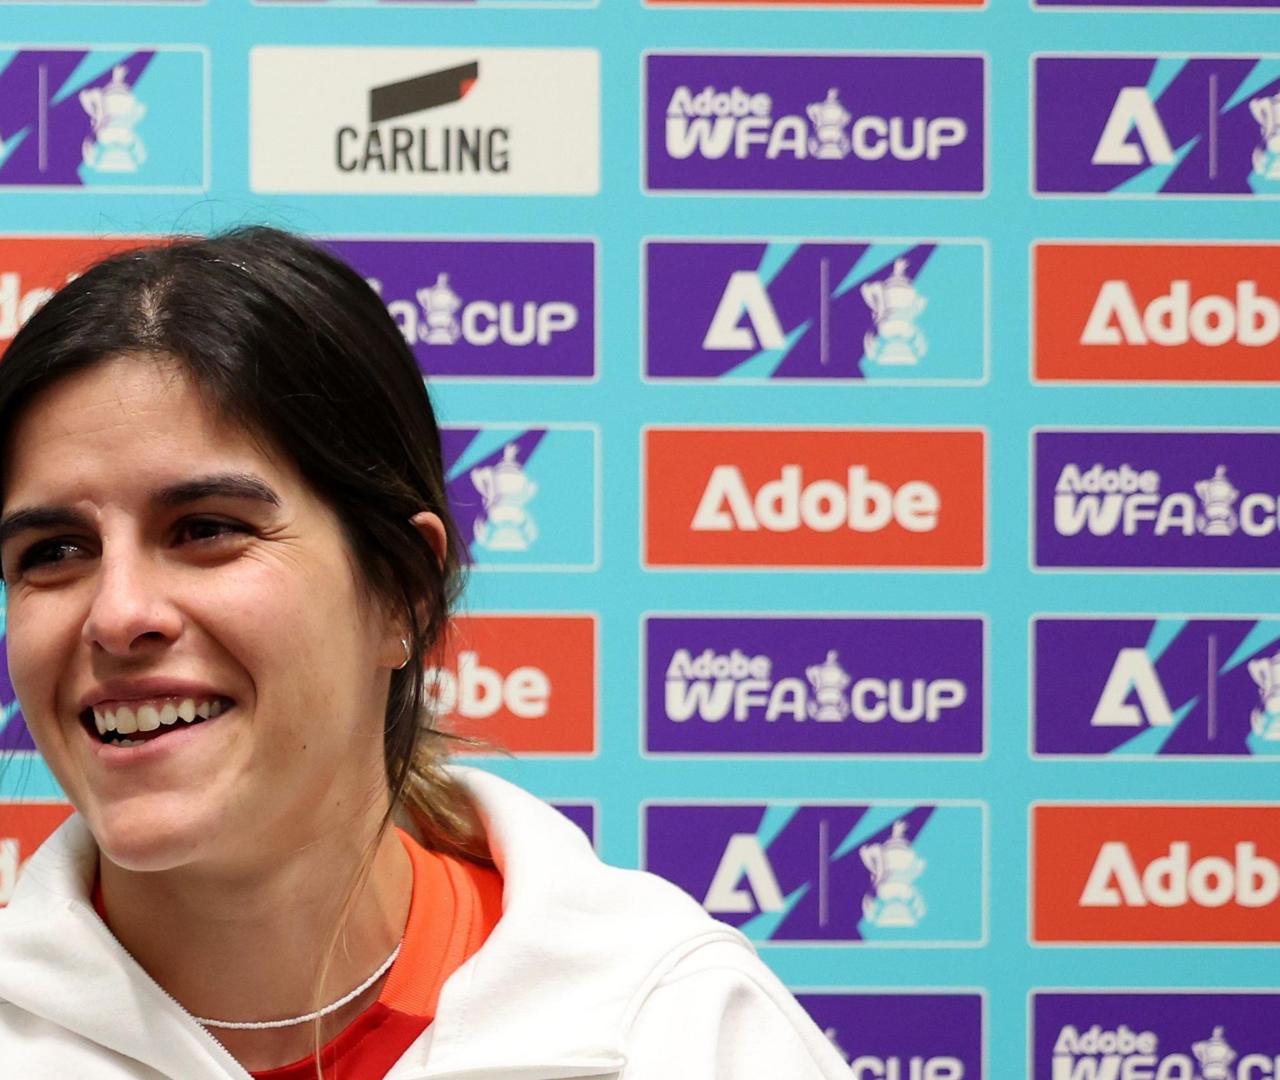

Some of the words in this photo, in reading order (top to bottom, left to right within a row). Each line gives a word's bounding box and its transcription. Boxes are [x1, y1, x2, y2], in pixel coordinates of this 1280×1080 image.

[668, 87, 771, 116] Adobe
[336, 127, 508, 173] CARLING
[856, 117, 966, 160] CUP
[461, 302, 577, 345] CUP
[1081, 281, 1280, 345] Adob
[692, 466, 939, 531] Adobe
[1056, 465, 1159, 491] Adobe
[423, 651, 551, 719] obe
[667, 650, 770, 678] Adobe
[855, 679, 965, 722] CUP
[1080, 843, 1280, 906] Adob
[1054, 1026, 1156, 1054] Adobe
